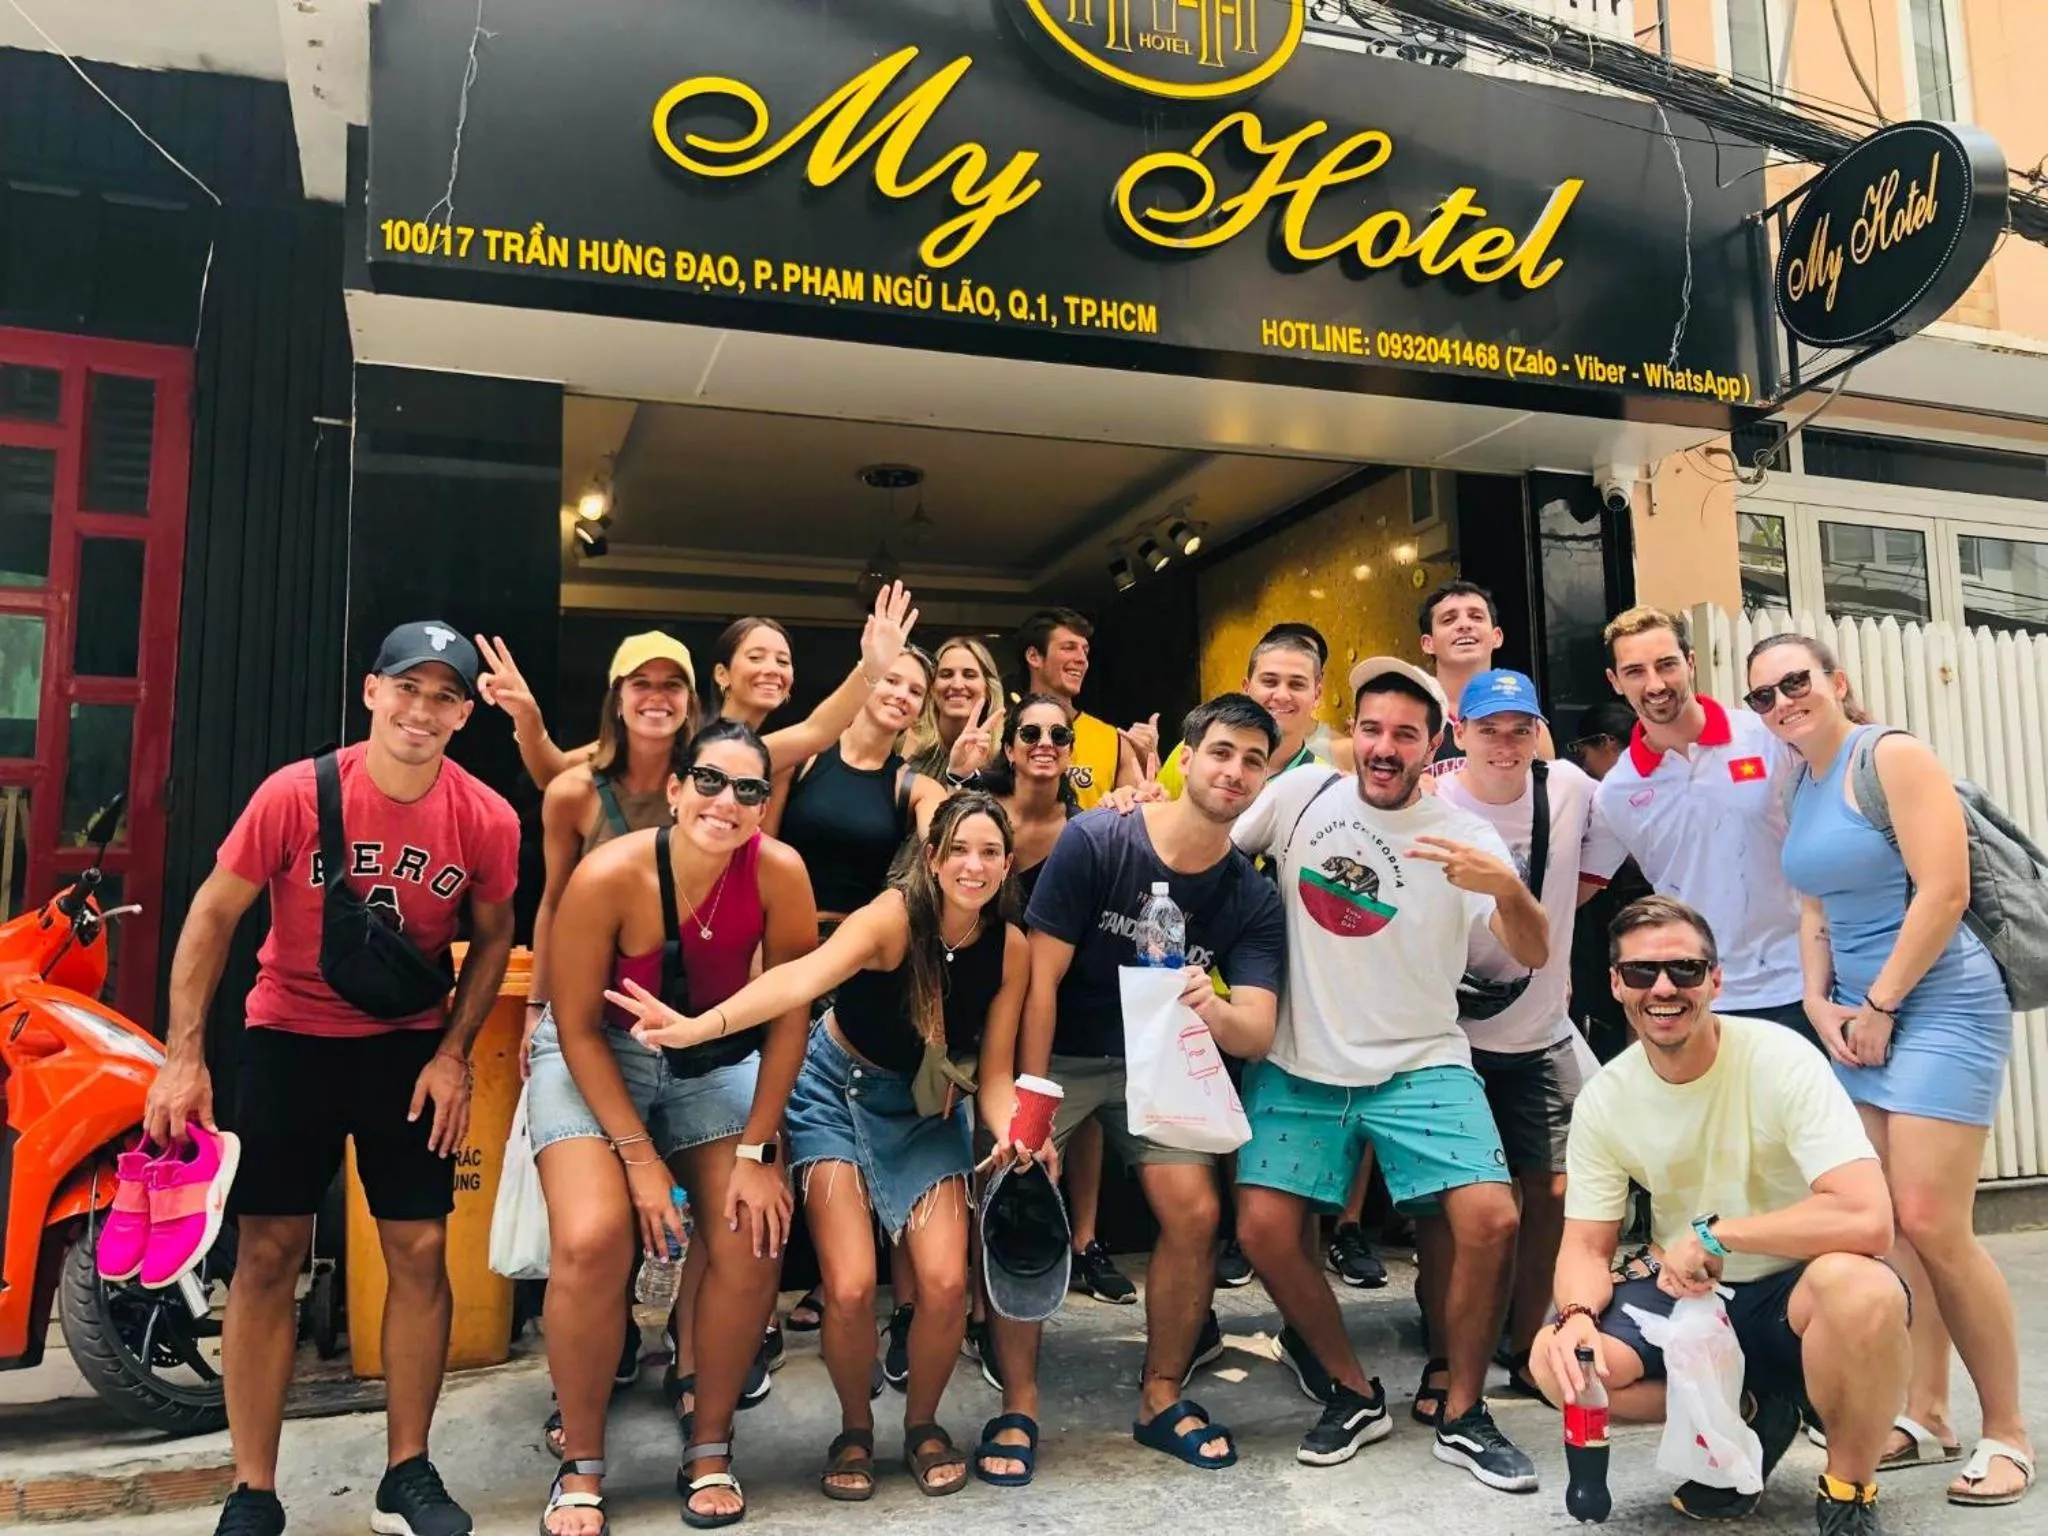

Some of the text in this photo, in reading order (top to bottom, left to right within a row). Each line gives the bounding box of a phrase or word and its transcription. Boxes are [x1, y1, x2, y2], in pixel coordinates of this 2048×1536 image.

[1139, 32, 1194, 55] HOTEL
[652, 46, 1584, 288] My Hotel
[380, 219, 475, 258] 100/17
[483, 221, 568, 269] TRẦN
[579, 239, 665, 278] HƯNG
[675, 250, 745, 294] ĐẠO,
[873, 274, 932, 309] NGŨ
[941, 279, 1000, 322] LÃO,
[1008, 289, 1057, 328] Q.1,
[1064, 296, 1157, 334] TP.HCM
[1787, 151, 1940, 312] My Hotel
[1261, 318, 1371, 356] HOTLINE:
[1375, 331, 1500, 370] 0932041468
[1505, 346, 1557, 379] (Zalo
[1575, 354, 1625, 384] Viber
[1643, 362, 1752, 402] WhatsApp)
[1310, 821, 1404, 888] SOUTH CIFORNIA
